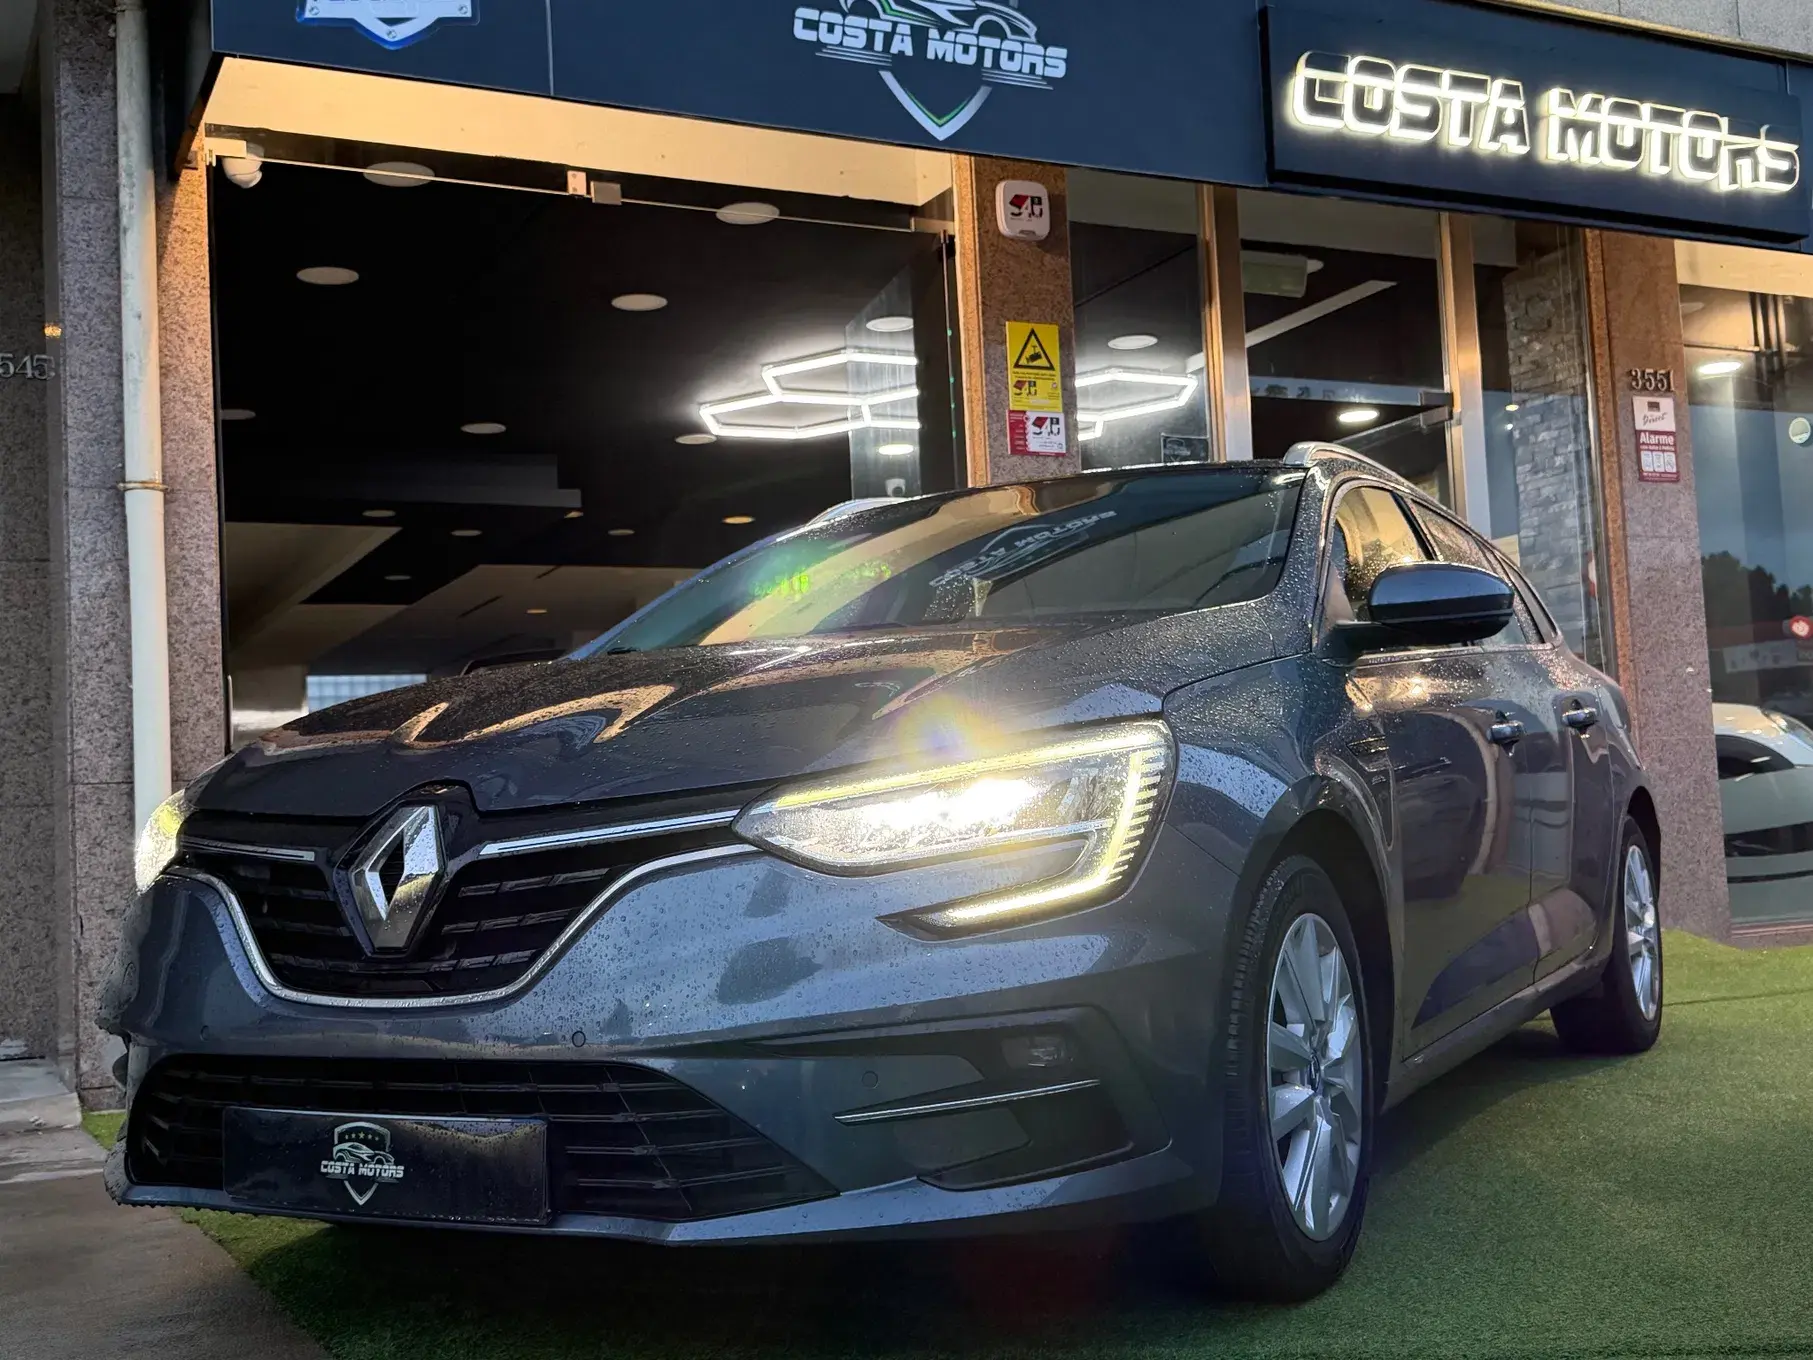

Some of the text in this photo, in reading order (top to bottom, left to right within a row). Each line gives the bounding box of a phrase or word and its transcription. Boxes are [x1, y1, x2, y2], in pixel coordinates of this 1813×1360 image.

[793, 7, 1068, 79] COSTA MOTORS
[1292, 50, 1800, 192] COSTA MOTORS
[1631, 368, 1674, 391] 3551
[1640, 432, 1674, 445] Alarme
[320, 1160, 405, 1178] COSTA MOTORS
